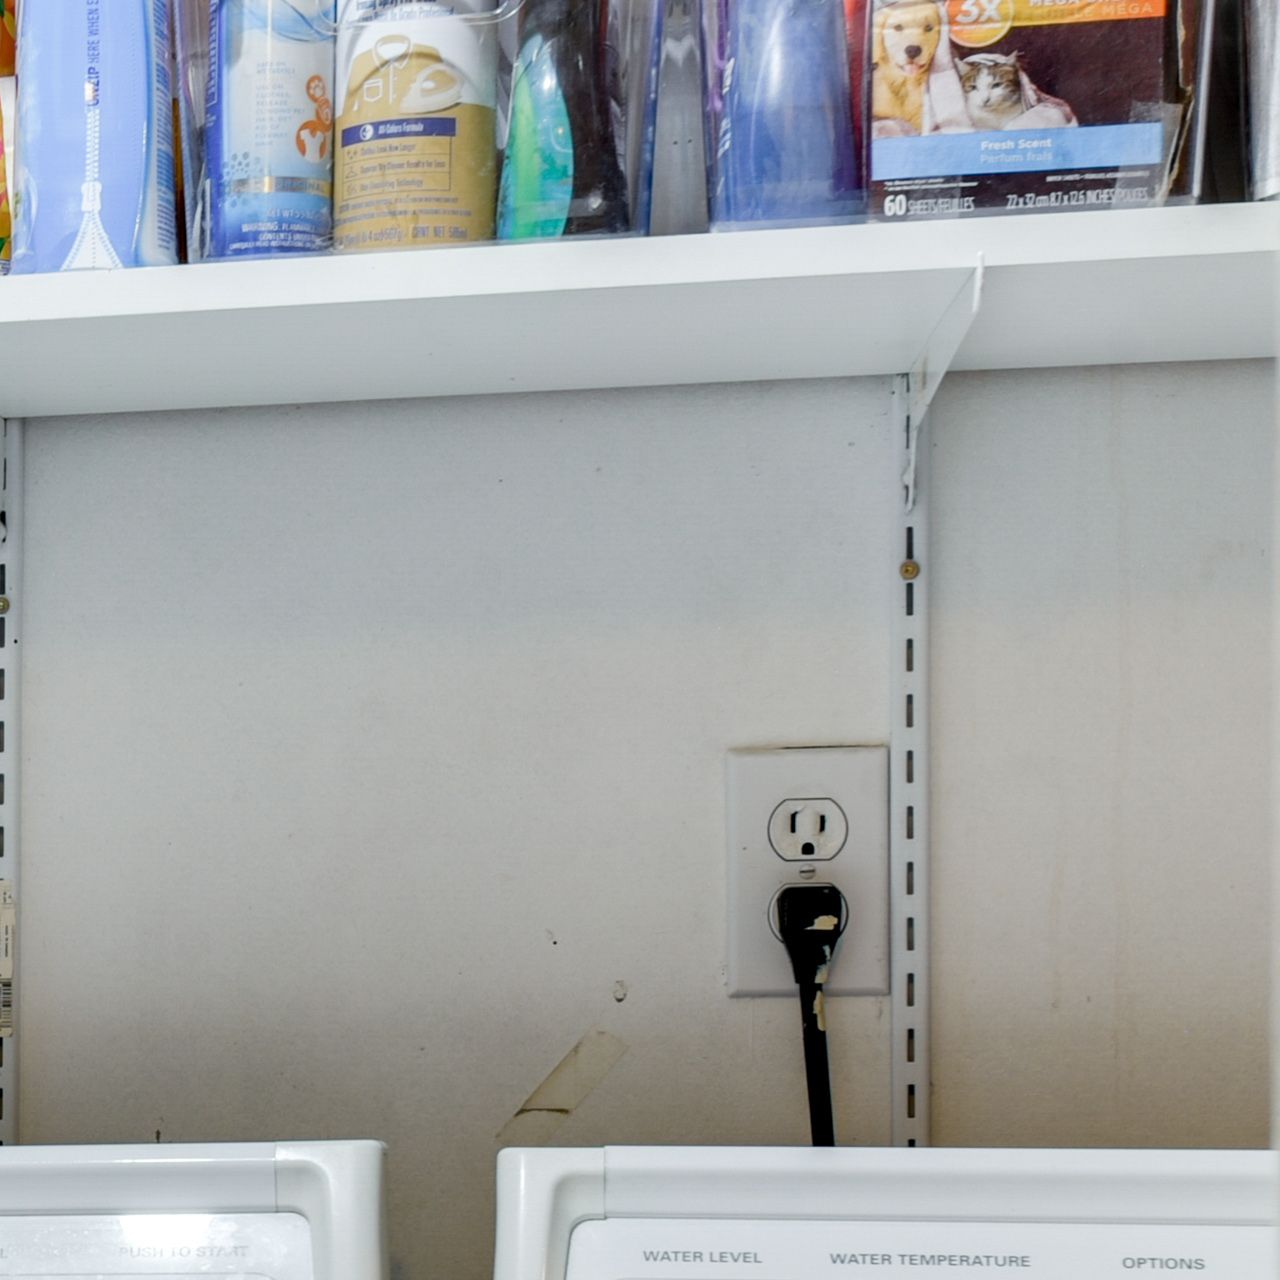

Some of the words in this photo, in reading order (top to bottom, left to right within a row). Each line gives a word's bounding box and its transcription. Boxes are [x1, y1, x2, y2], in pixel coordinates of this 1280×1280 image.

[87, 8, 100, 37] WHEN
[981, 140, 1014, 151] Fresh
[1018, 138, 1053, 150] Scent
[883, 194, 907, 216] 60
[118, 1246, 165, 1259] PUSH
[195, 1245, 249, 1258] START
[643, 1250, 704, 1262] WATER
[709, 1251, 763, 1264] LEVEL
[830, 1253, 892, 1265] WATER
[898, 1254, 1031, 1267] TEMPERATURE
[1122, 1257, 1206, 1270] OPTIONS
